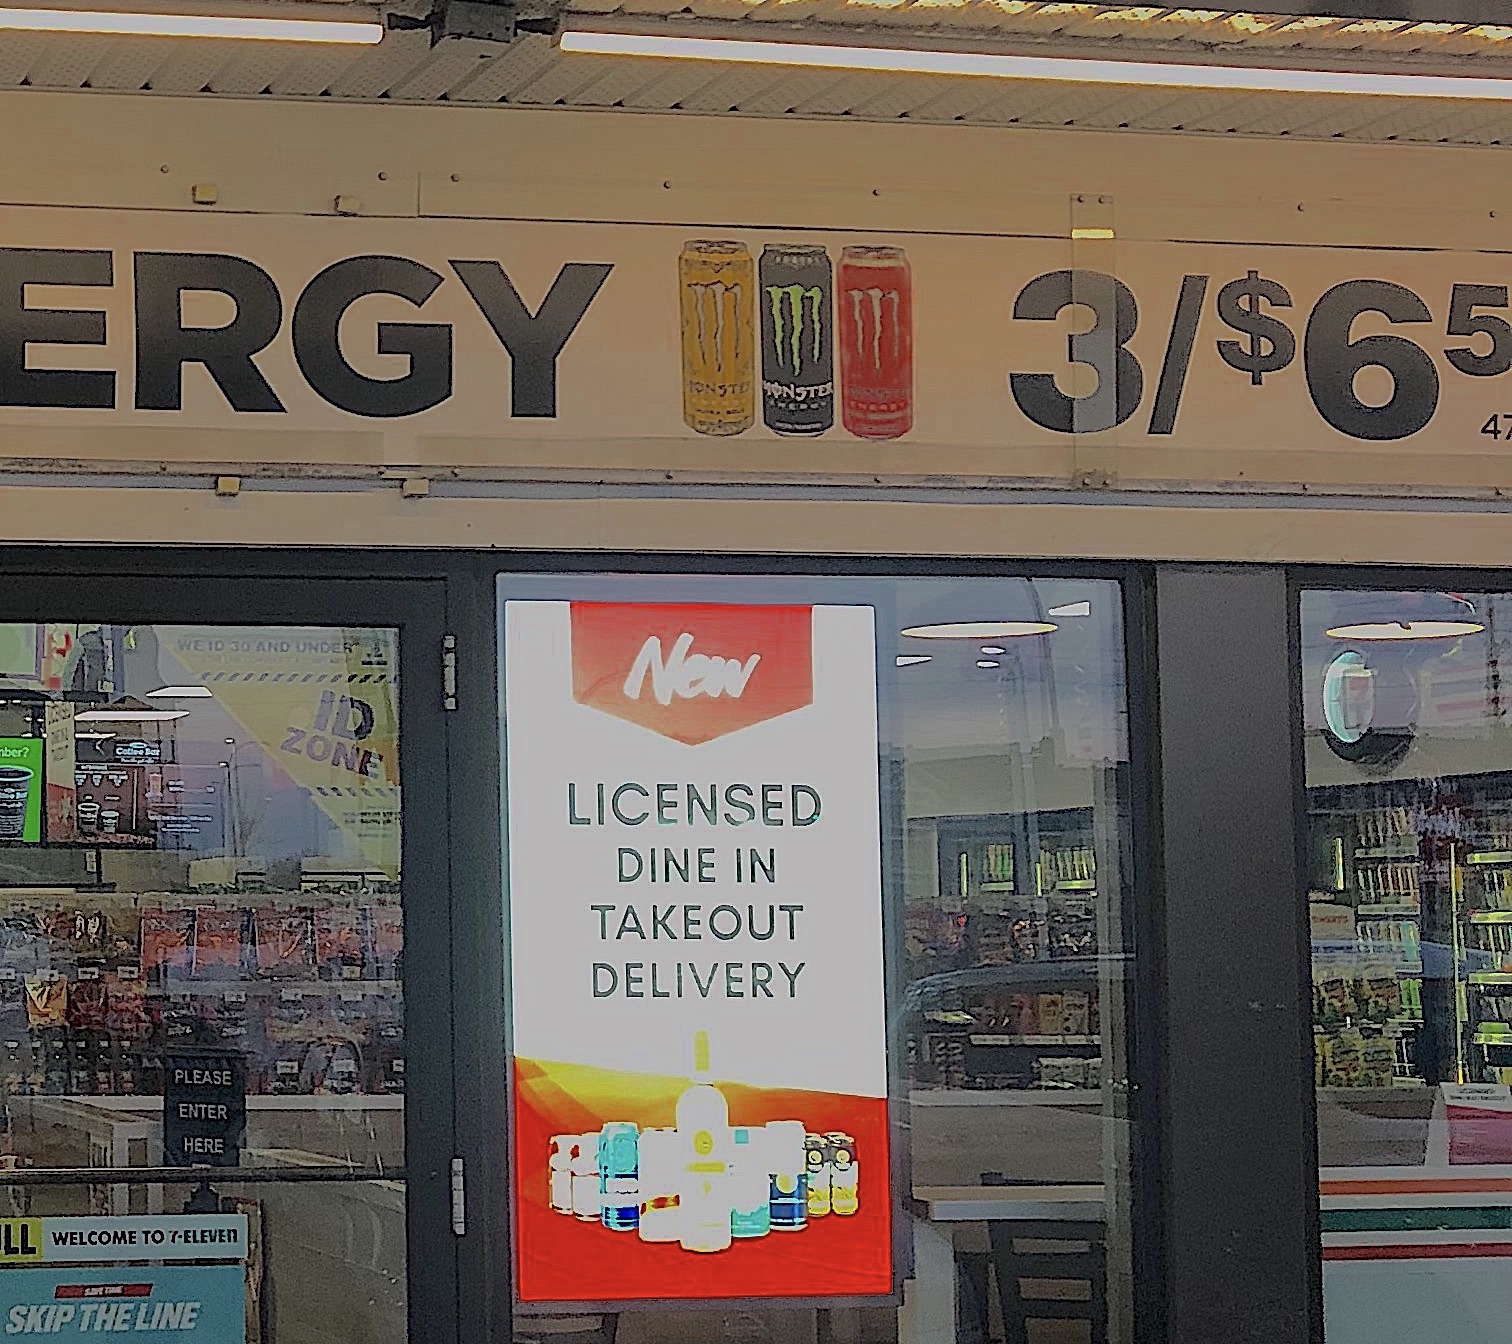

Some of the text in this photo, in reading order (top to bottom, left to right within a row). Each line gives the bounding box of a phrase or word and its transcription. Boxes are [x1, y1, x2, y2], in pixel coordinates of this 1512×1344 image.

[177, 639, 205, 652] WE
[208, 639, 224, 652] ID
[230, 640, 250, 653] 30
[255, 640, 289, 653] AND
[623, 632, 762, 706] New
[314, 690, 375, 740] ID
[280, 727, 384, 777] ZONE
[568, 782, 822, 827] LICENSED
[617, 848, 776, 884] DINE IN
[590, 903, 805, 941] TAKEOUT
[591, 961, 806, 1000] DELIVERY
[174, 1068, 233, 1086] PLEASE
[178, 1103, 228, 1120] ENTER
[183, 1137, 225, 1154] HERE
[52, 1229, 137, 1246] WELCOME
[142, 1229, 165, 1245] TO
[5, 1301, 201, 1335] SKIP THE LINE
